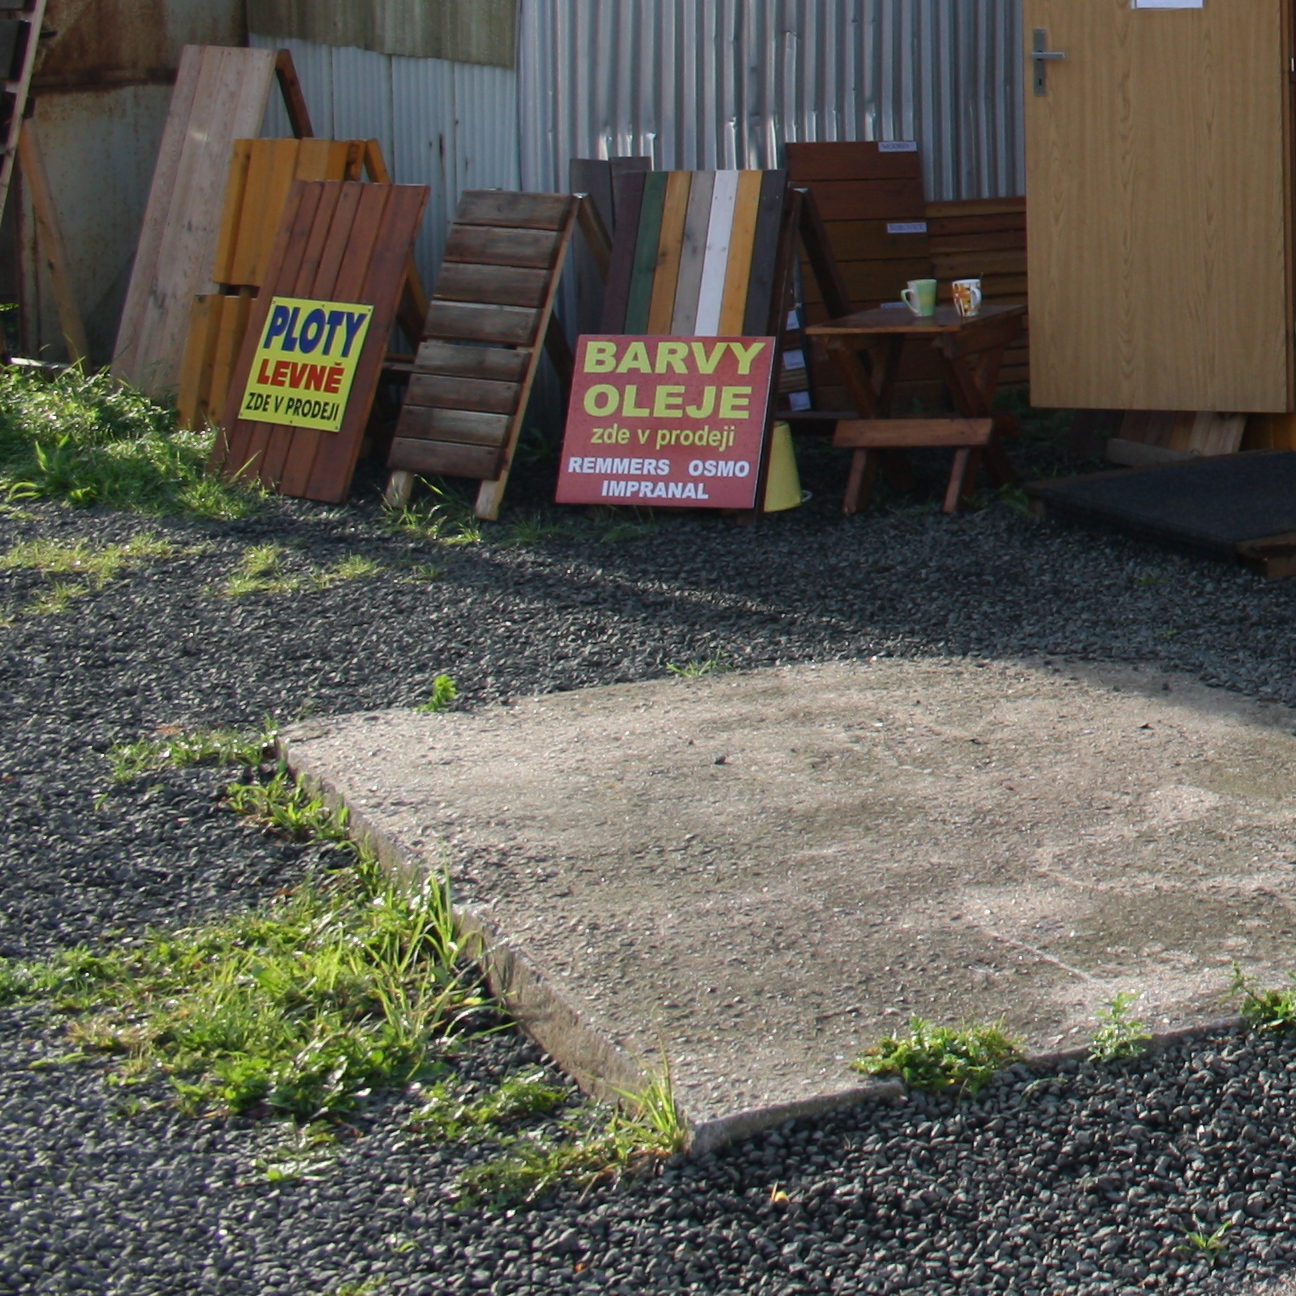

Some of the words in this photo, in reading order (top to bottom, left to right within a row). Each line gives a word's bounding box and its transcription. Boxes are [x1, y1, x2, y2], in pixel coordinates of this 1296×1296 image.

[262, 304, 368, 358] PLOTY
[583, 341, 766, 375] BARVY
[256, 359, 345, 394] LEVNĚ
[245, 392, 271, 412] ZDE
[274, 396, 285, 414] V
[284, 396, 340, 422] PRODEJI
[583, 384, 752, 419] OLEJE
[590, 424, 631, 445] zde
[637, 429, 651, 444] v
[655, 425, 736, 452] prodeji
[567, 456, 670, 476] REMMERS
[688, 460, 750, 478] OSMO
[601, 479, 709, 500] IMPRANAL
